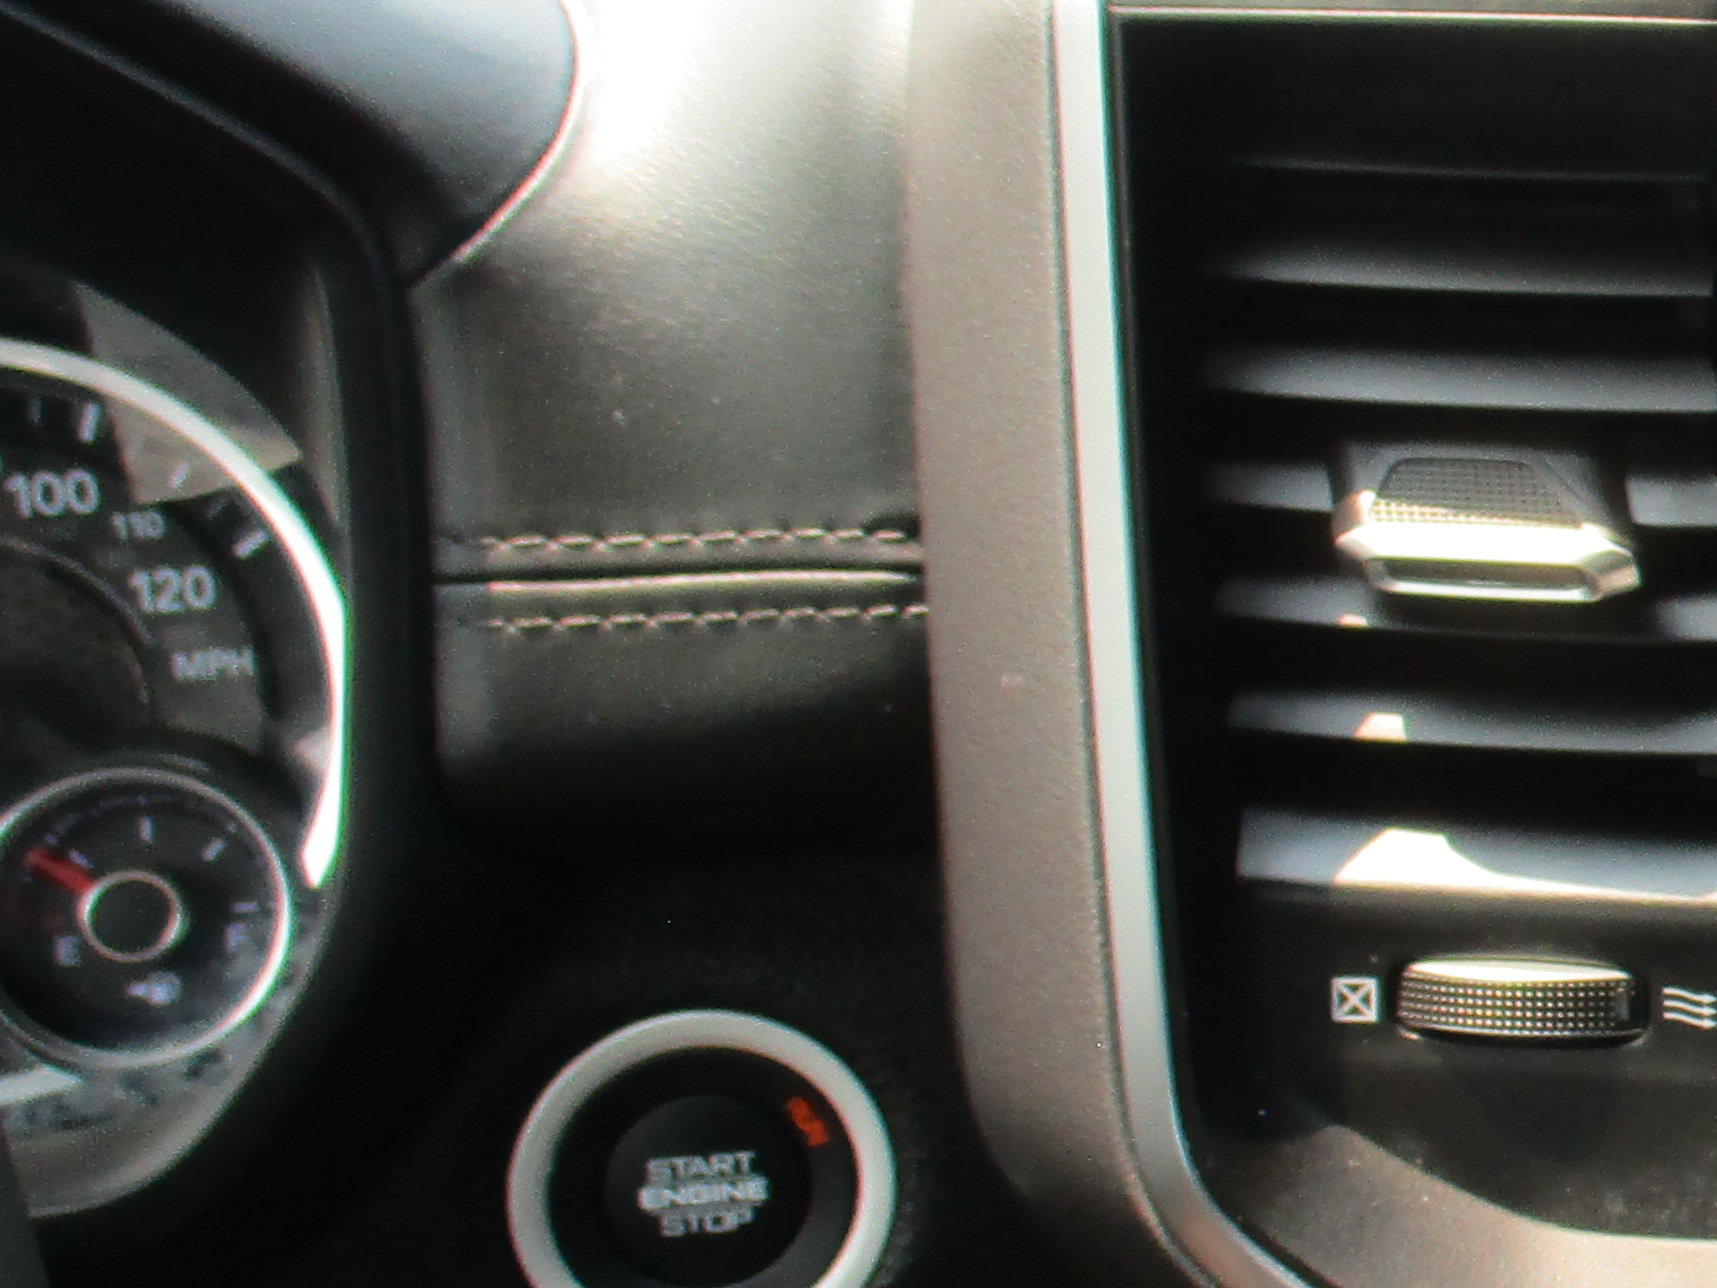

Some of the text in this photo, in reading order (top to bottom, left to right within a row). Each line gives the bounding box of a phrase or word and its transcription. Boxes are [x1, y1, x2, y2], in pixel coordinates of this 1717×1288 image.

[4, 469, 99, 518] 100
[129, 566, 217, 612] 120
[171, 647, 254, 681] MPH
[646, 1150, 754, 1182] START
[637, 1175, 769, 1211] ENGINE
[660, 1206, 755, 1237] STOP
